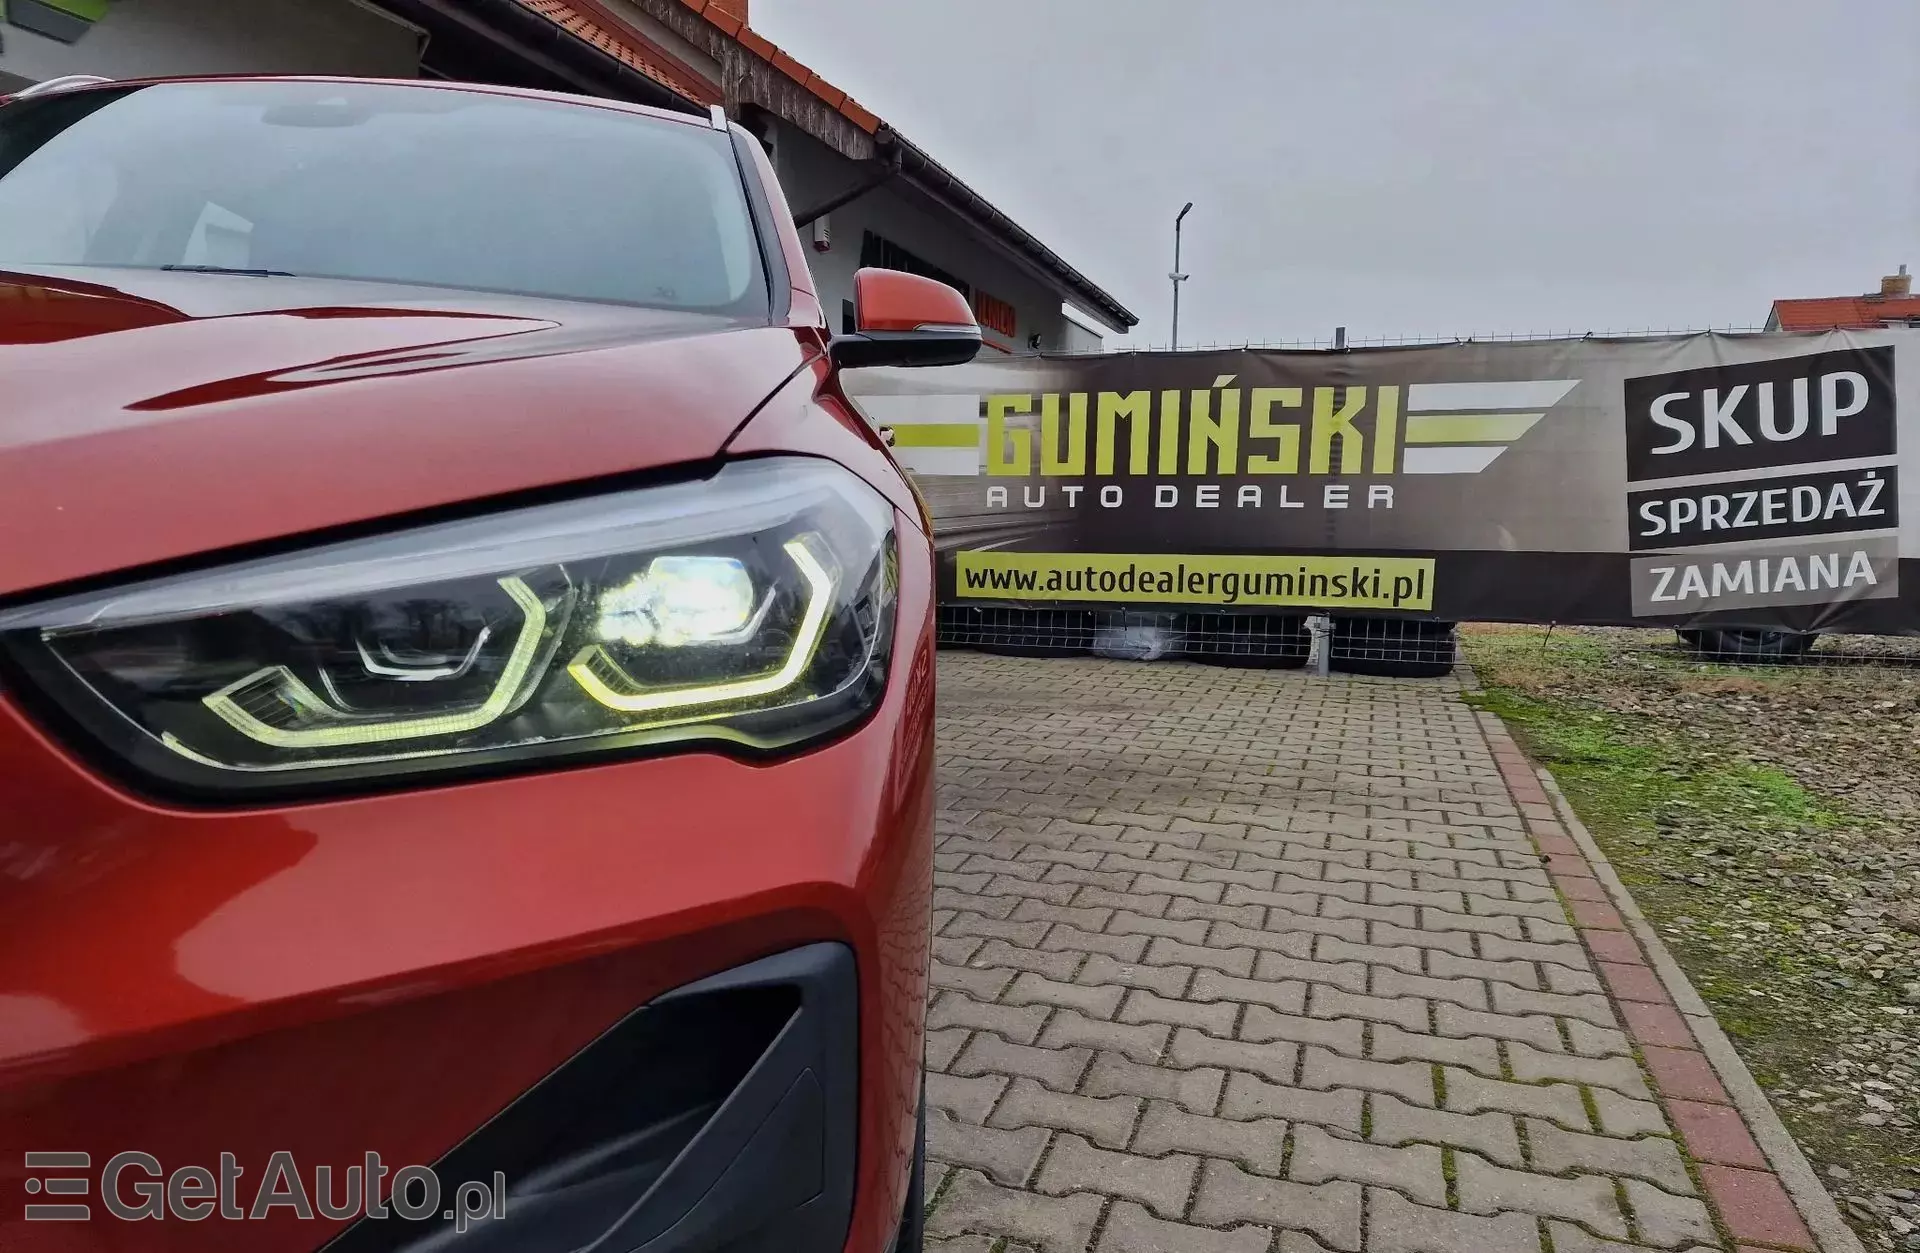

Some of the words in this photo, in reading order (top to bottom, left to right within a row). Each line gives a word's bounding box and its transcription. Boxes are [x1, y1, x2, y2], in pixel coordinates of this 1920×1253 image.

[987, 375, 1400, 476] GUMIŃSKI
[1650, 371, 1869, 454] SKUP
[986, 485, 1123, 508] AUTO
[1154, 485, 1393, 508] DEALER
[1639, 471, 1885, 536] SPRZEDAŻ
[965, 564, 1425, 606] www.autodealerguminski.pl
[1650, 551, 1877, 601] ZAMIANA
